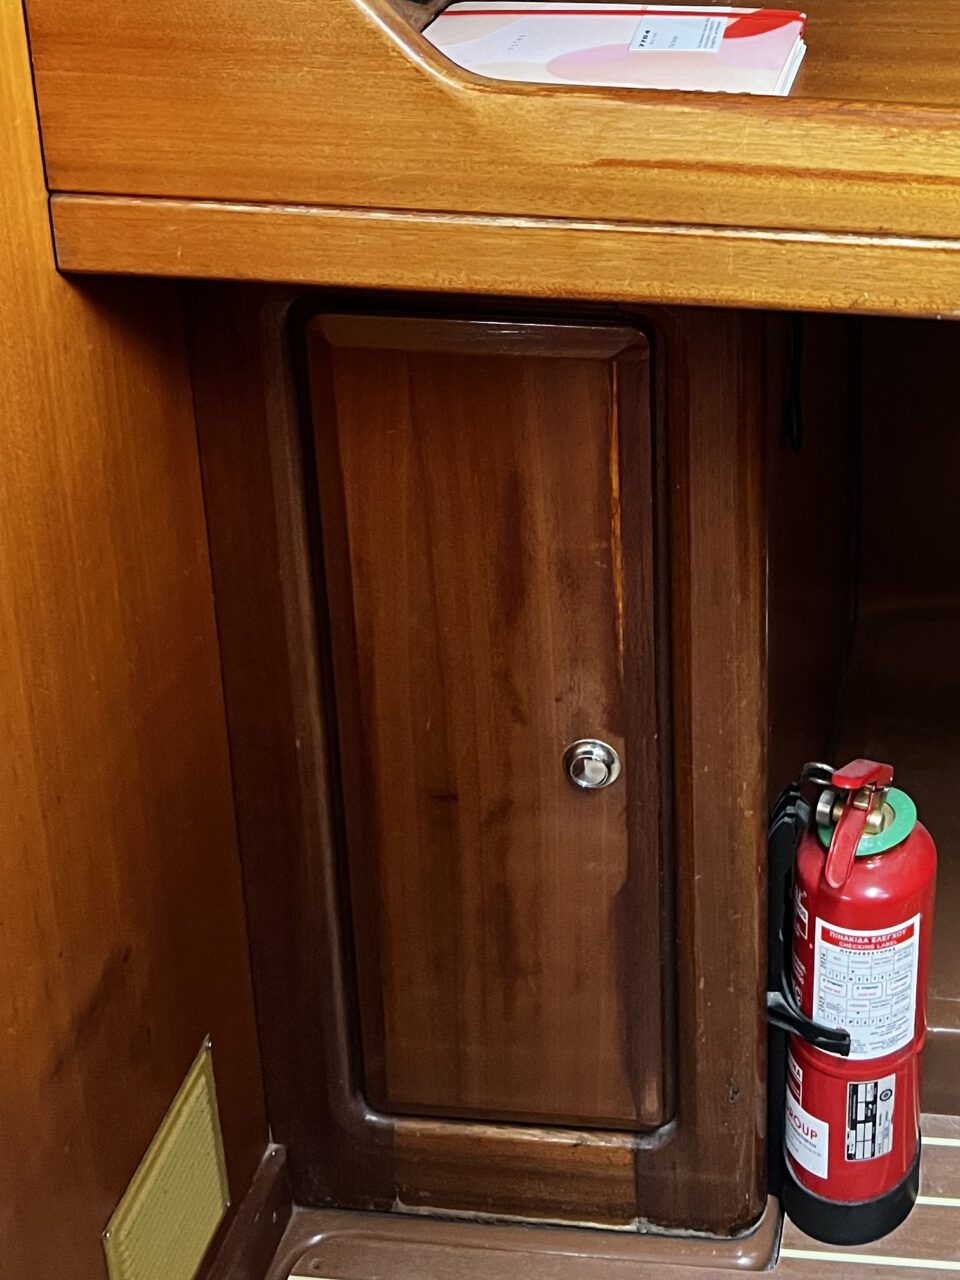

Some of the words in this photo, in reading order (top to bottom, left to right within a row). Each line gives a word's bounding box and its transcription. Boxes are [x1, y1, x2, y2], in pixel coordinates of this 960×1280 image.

[830, 930, 869, 943] ΠΙΝΑΚΙΔΑ
[871, 928, 907, 942] ΕΛΕΓΧΟΥ
[839, 941, 875, 949] CHECKING
[876, 940, 898, 949] LABEL
